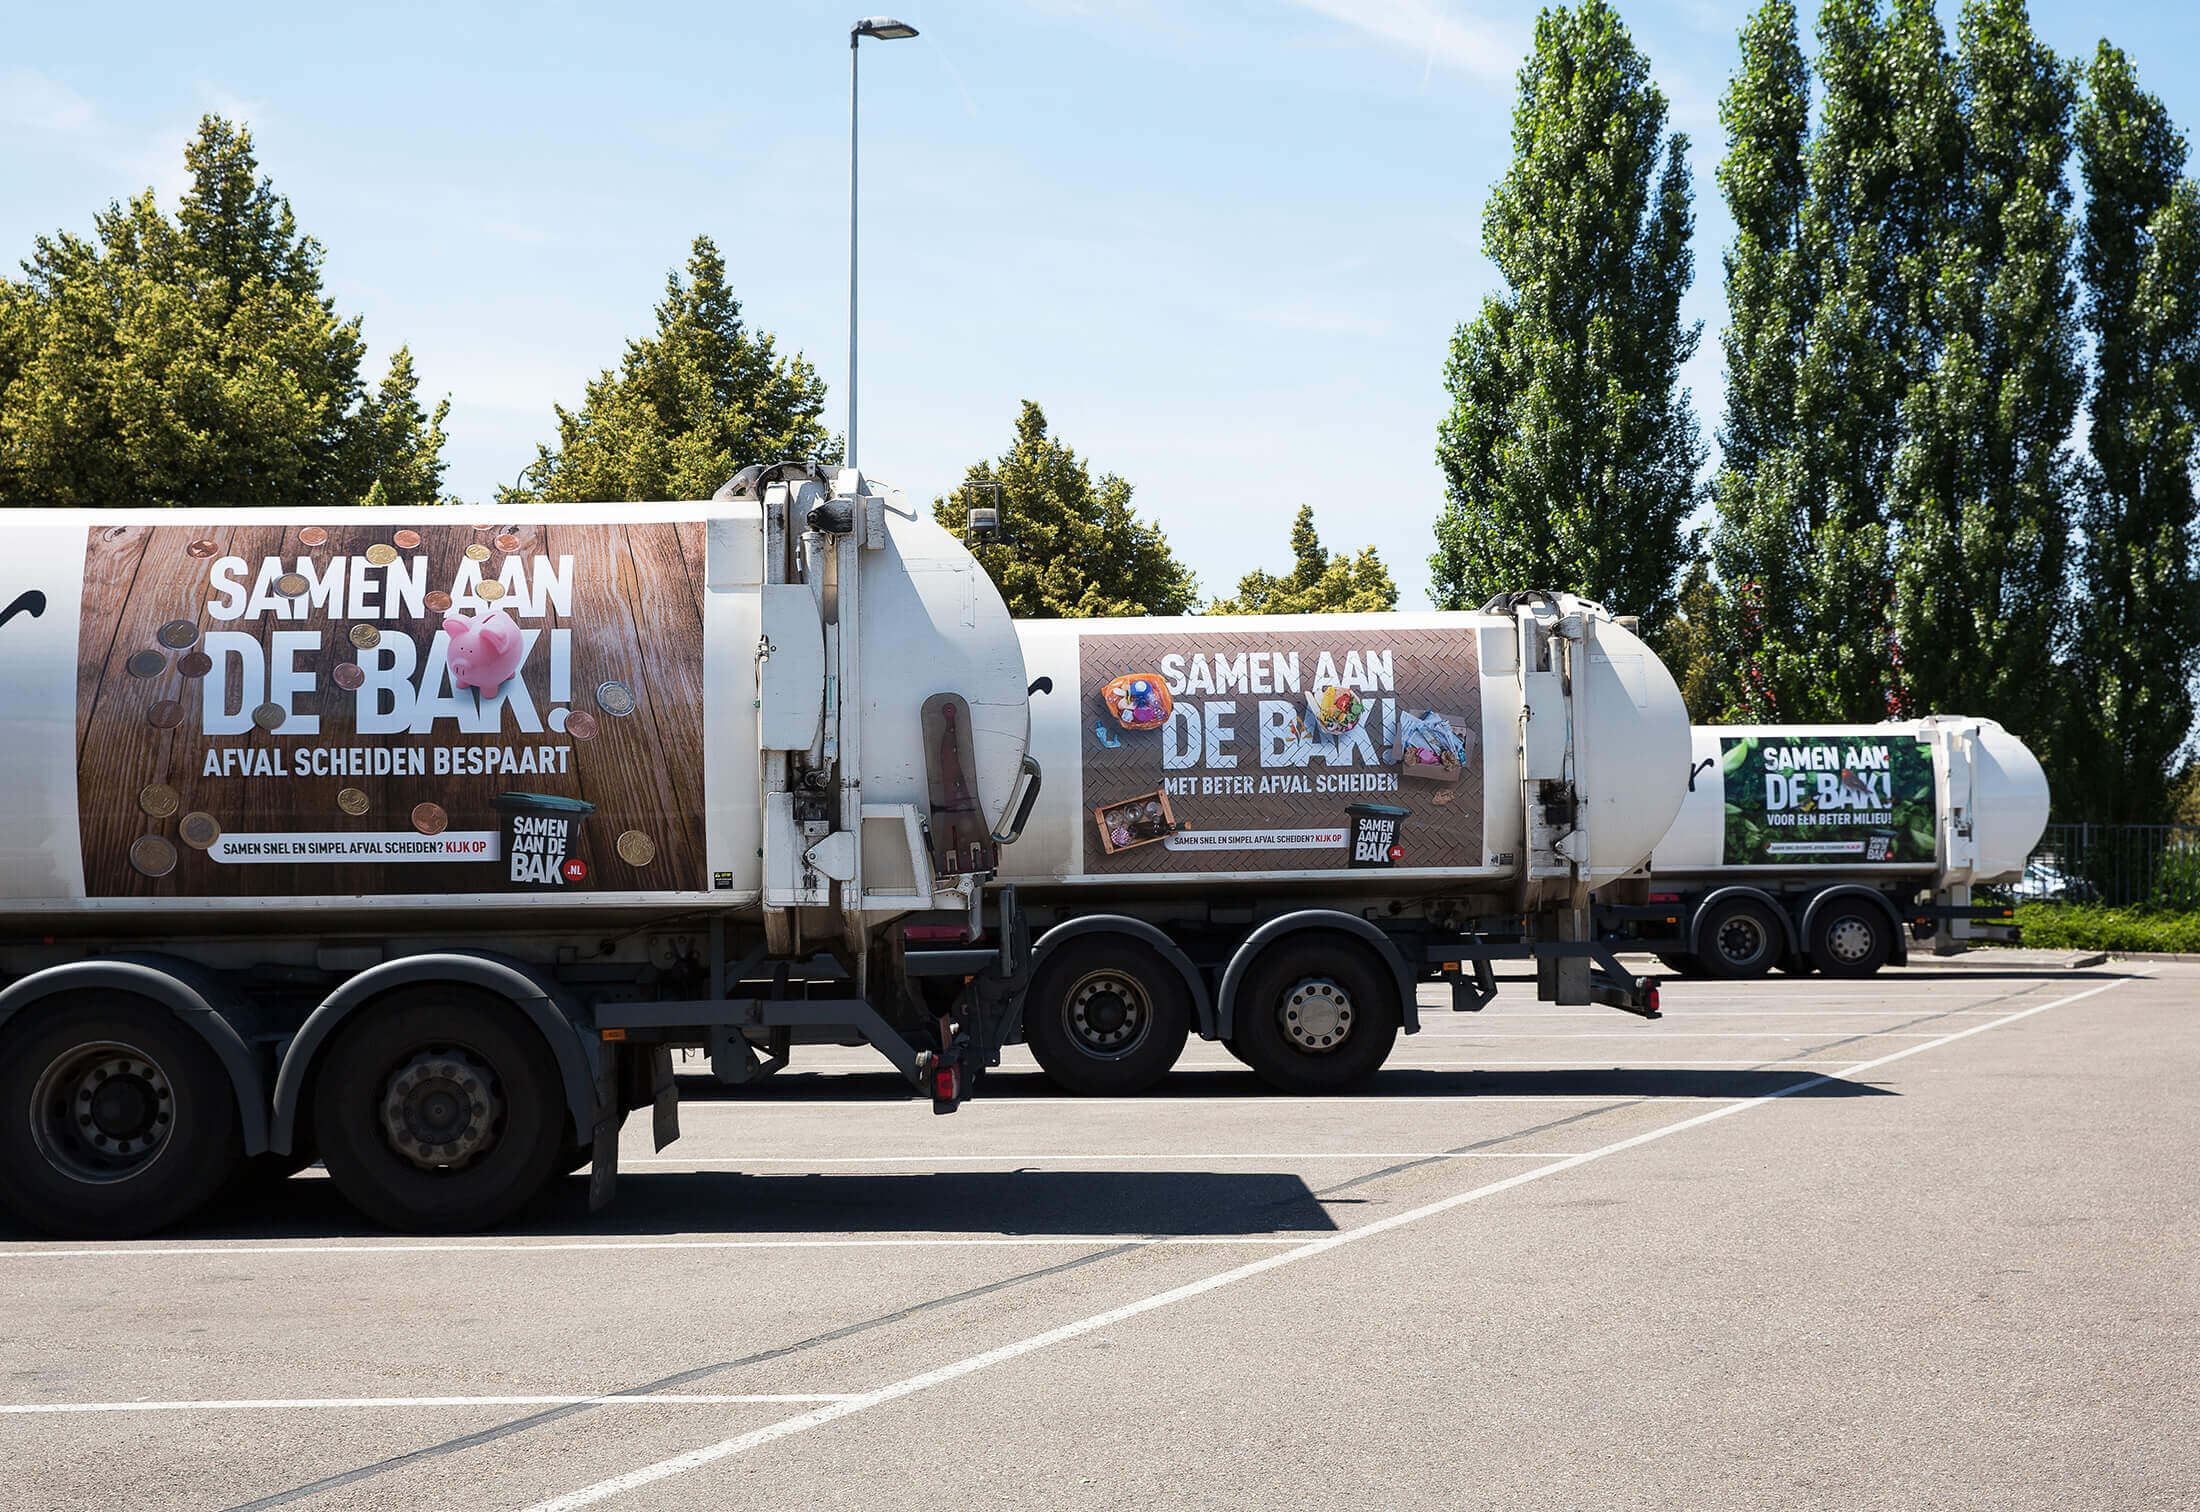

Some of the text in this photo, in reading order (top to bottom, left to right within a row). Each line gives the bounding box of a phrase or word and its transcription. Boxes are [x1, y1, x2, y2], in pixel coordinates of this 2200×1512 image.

[207, 555, 574, 621] SAMEN AAN
[203, 629, 572, 736] DE BAK!
[1160, 650, 1395, 696] SAMEN AAN
[1162, 698, 1397, 770] DE BAK!
[203, 746, 571, 777] AFVAL SCHEIDEN BESPAART
[1763, 745, 1890, 771] SAMEN AAN
[1164, 773, 1399, 796] MET BETER AFVAL SCHEIDEN
[513, 815, 568, 838] SAMEN
[1359, 818, 1395, 832] SAMEN
[1766, 812, 1892, 826] VOOR EEN BETER MILIEU!
[223, 840, 487, 855] SAMEN SNEL EN SIMPEL AFVAL SCHEIDEN? KIJK OP
[512, 835, 567, 855] AAN DE
[1174, 834, 1342, 845] SAMEN SNEL EN SIMPEL AFVAL SCHEIDEN? KIJK OP
[1357, 830, 1393, 844] AAN DE
[1355, 841, 1391, 863] BAK
[511, 852, 565, 885] BAK
